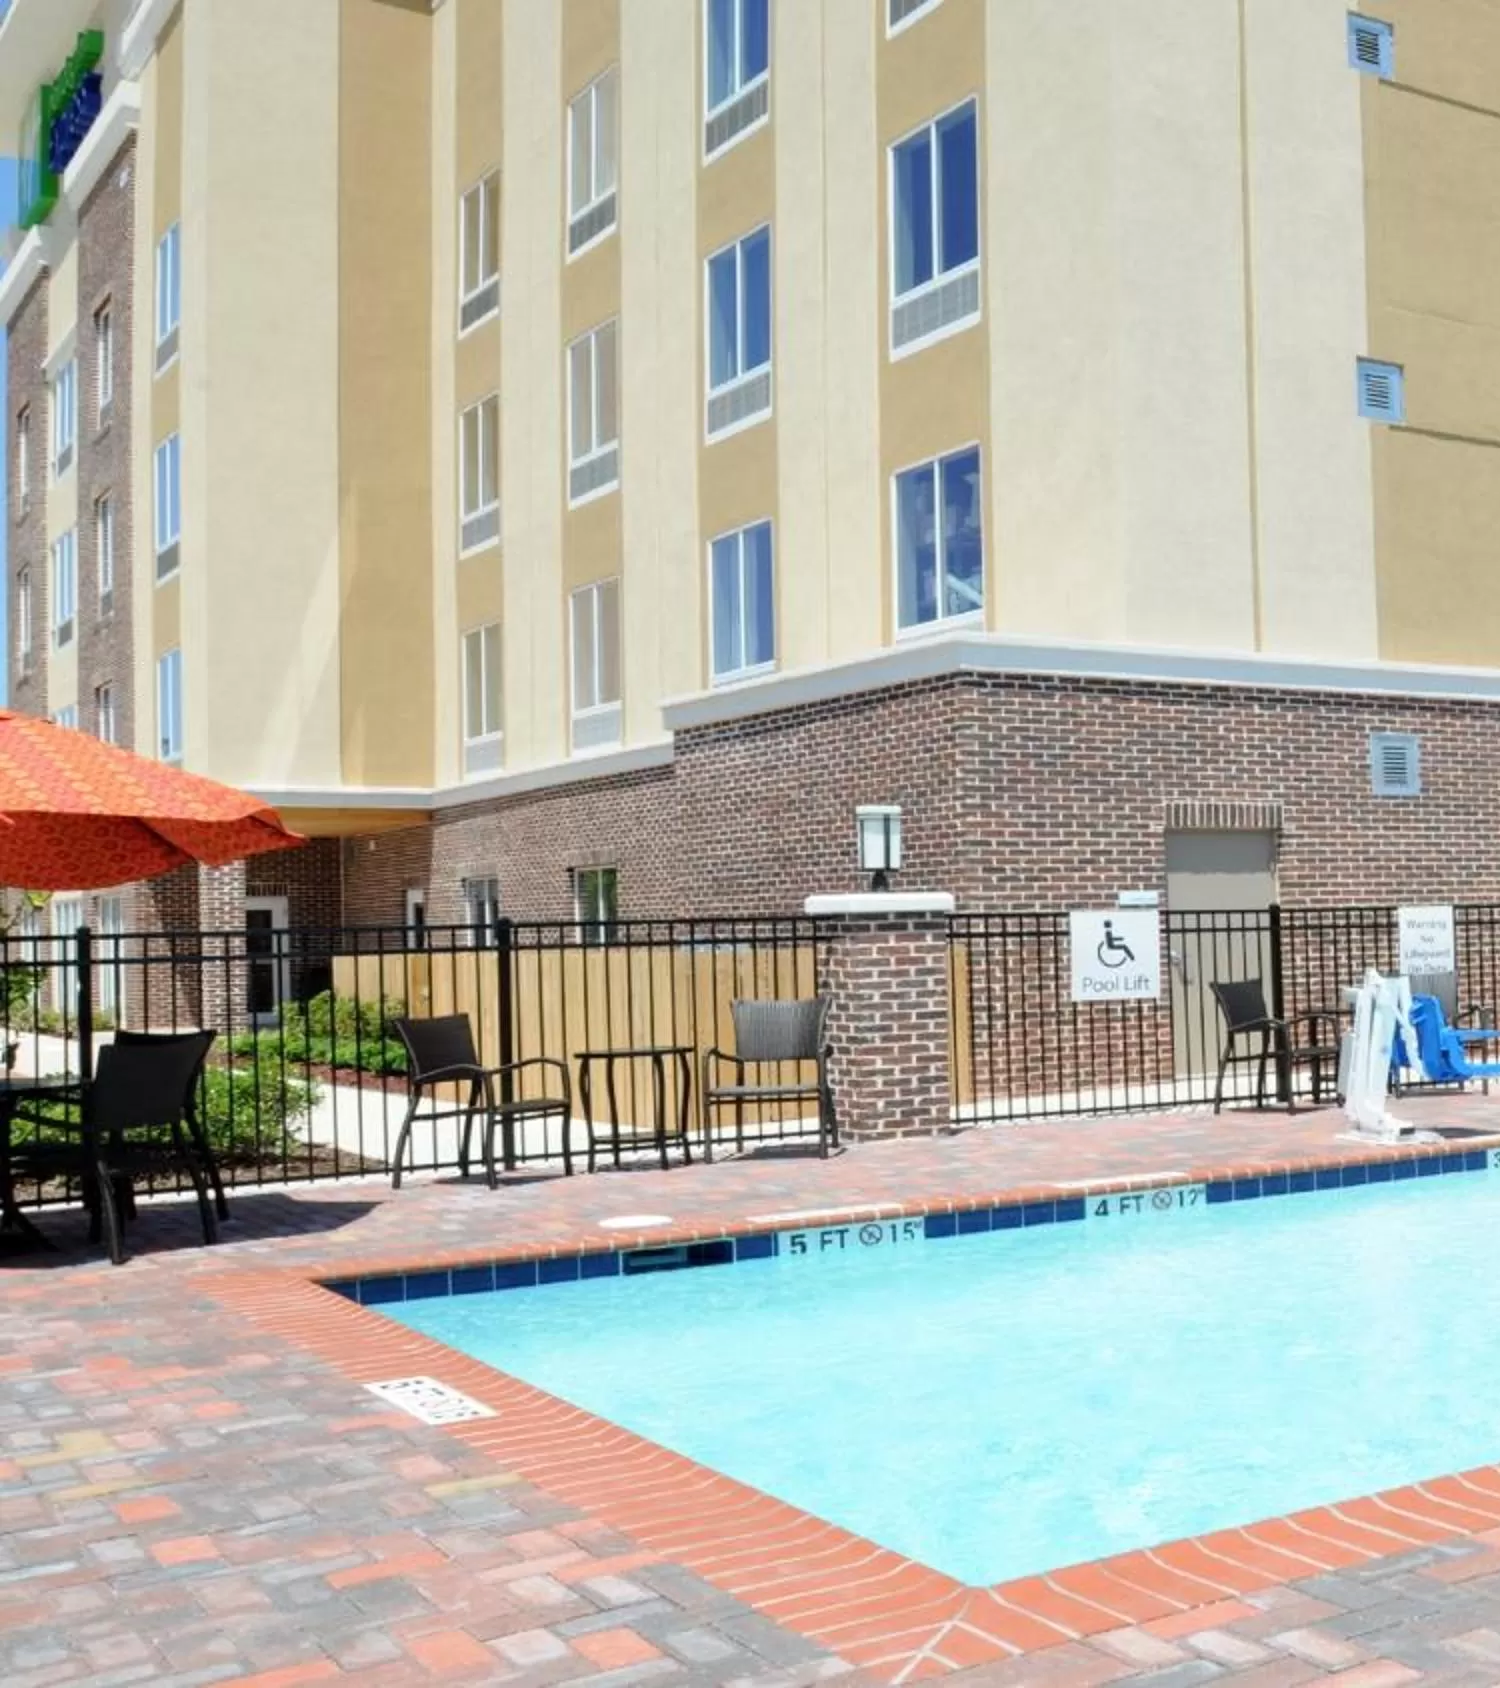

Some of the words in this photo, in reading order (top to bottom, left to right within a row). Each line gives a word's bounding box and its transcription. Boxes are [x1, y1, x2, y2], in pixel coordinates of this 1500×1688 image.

[1082, 976, 1119, 993] Pool
[1124, 975, 1151, 992] Lift
[1119, 1194, 1145, 1214] FT
[790, 1233, 807, 1254] 5
[820, 1228, 849, 1251] FT
